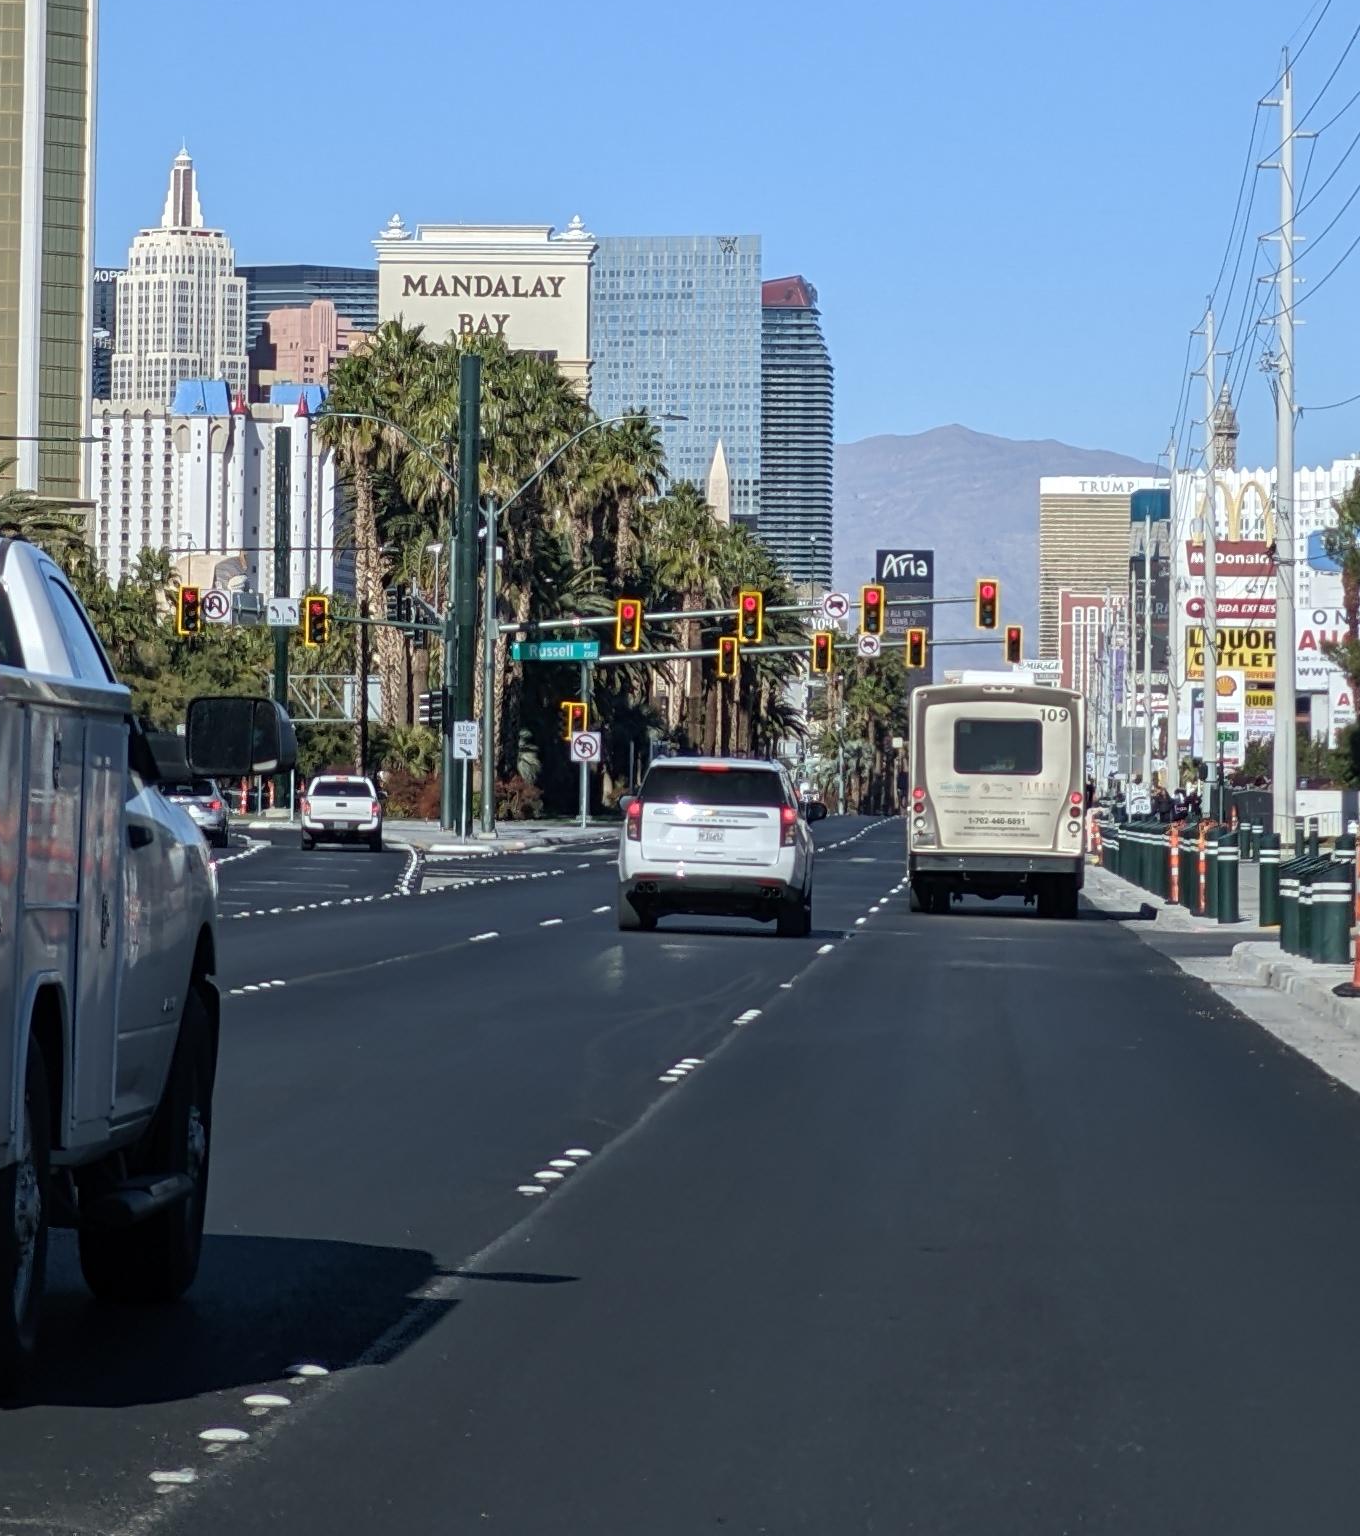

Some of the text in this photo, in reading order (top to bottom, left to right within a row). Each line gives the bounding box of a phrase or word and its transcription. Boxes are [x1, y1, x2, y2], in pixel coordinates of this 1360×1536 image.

[402, 275, 565, 298] MANDALAY
[458, 314, 510, 337] BAY
[1079, 481, 1134, 492] TRUMP
[882, 554, 928, 578] Aria
[1189, 629, 1276, 650] LIQUOR
[529, 645, 573, 657] Russell
[1195, 652, 1276, 667] OUTLET
[1245, 695, 1273, 706] QUOR
[1040, 708, 1069, 723] 109
